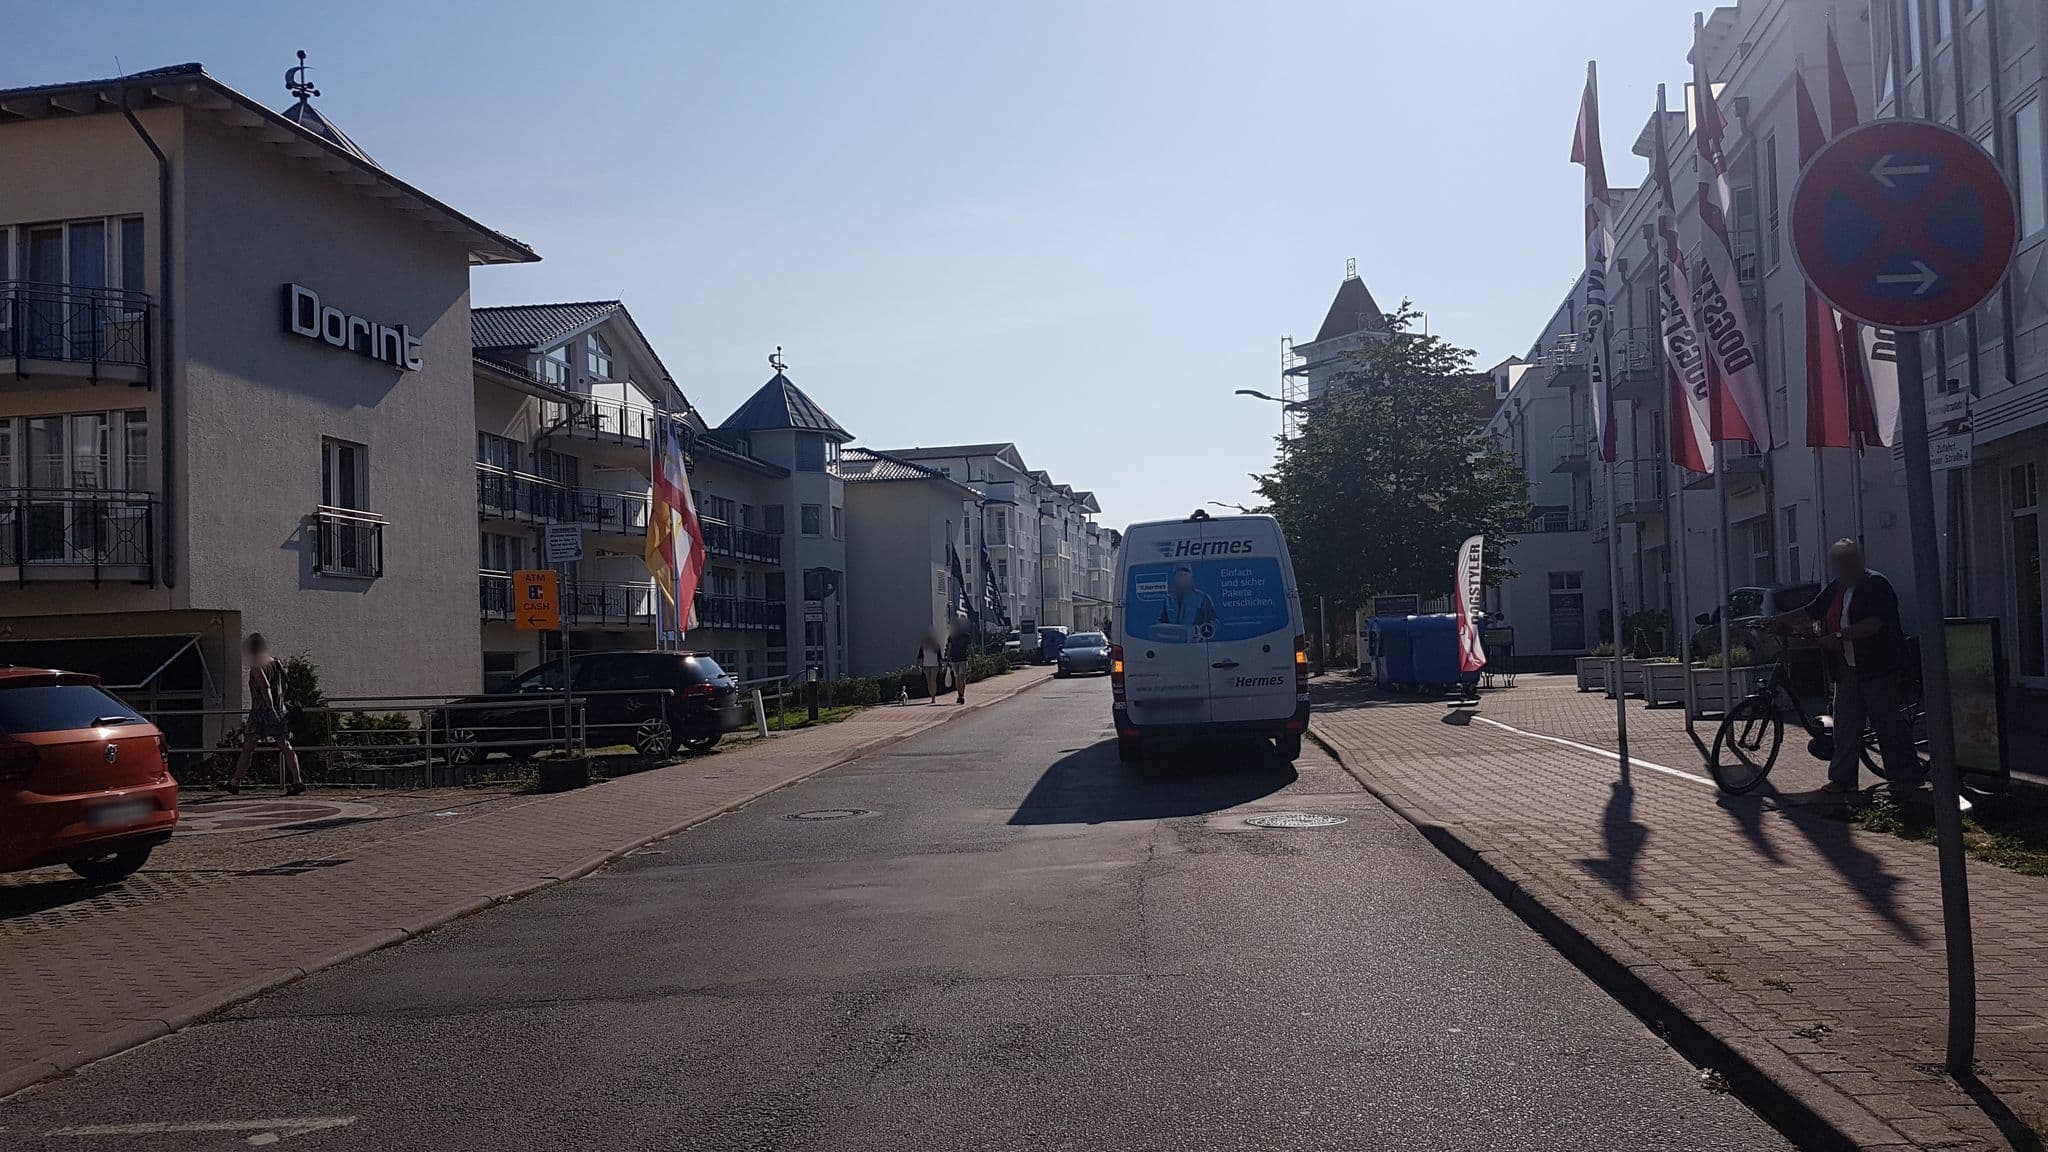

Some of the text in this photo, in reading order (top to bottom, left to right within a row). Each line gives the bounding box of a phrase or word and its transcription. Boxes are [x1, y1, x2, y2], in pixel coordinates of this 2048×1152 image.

[289, 283, 424, 373] Dorint
[1174, 539, 1253, 557] Hermes
[1220, 568, 1253, 577] Einfach
[525, 573, 546, 582] ATM
[1221, 578, 1239, 587] und
[523, 602, 550, 611] CASH
[1235, 675, 1285, 688] Hermes
